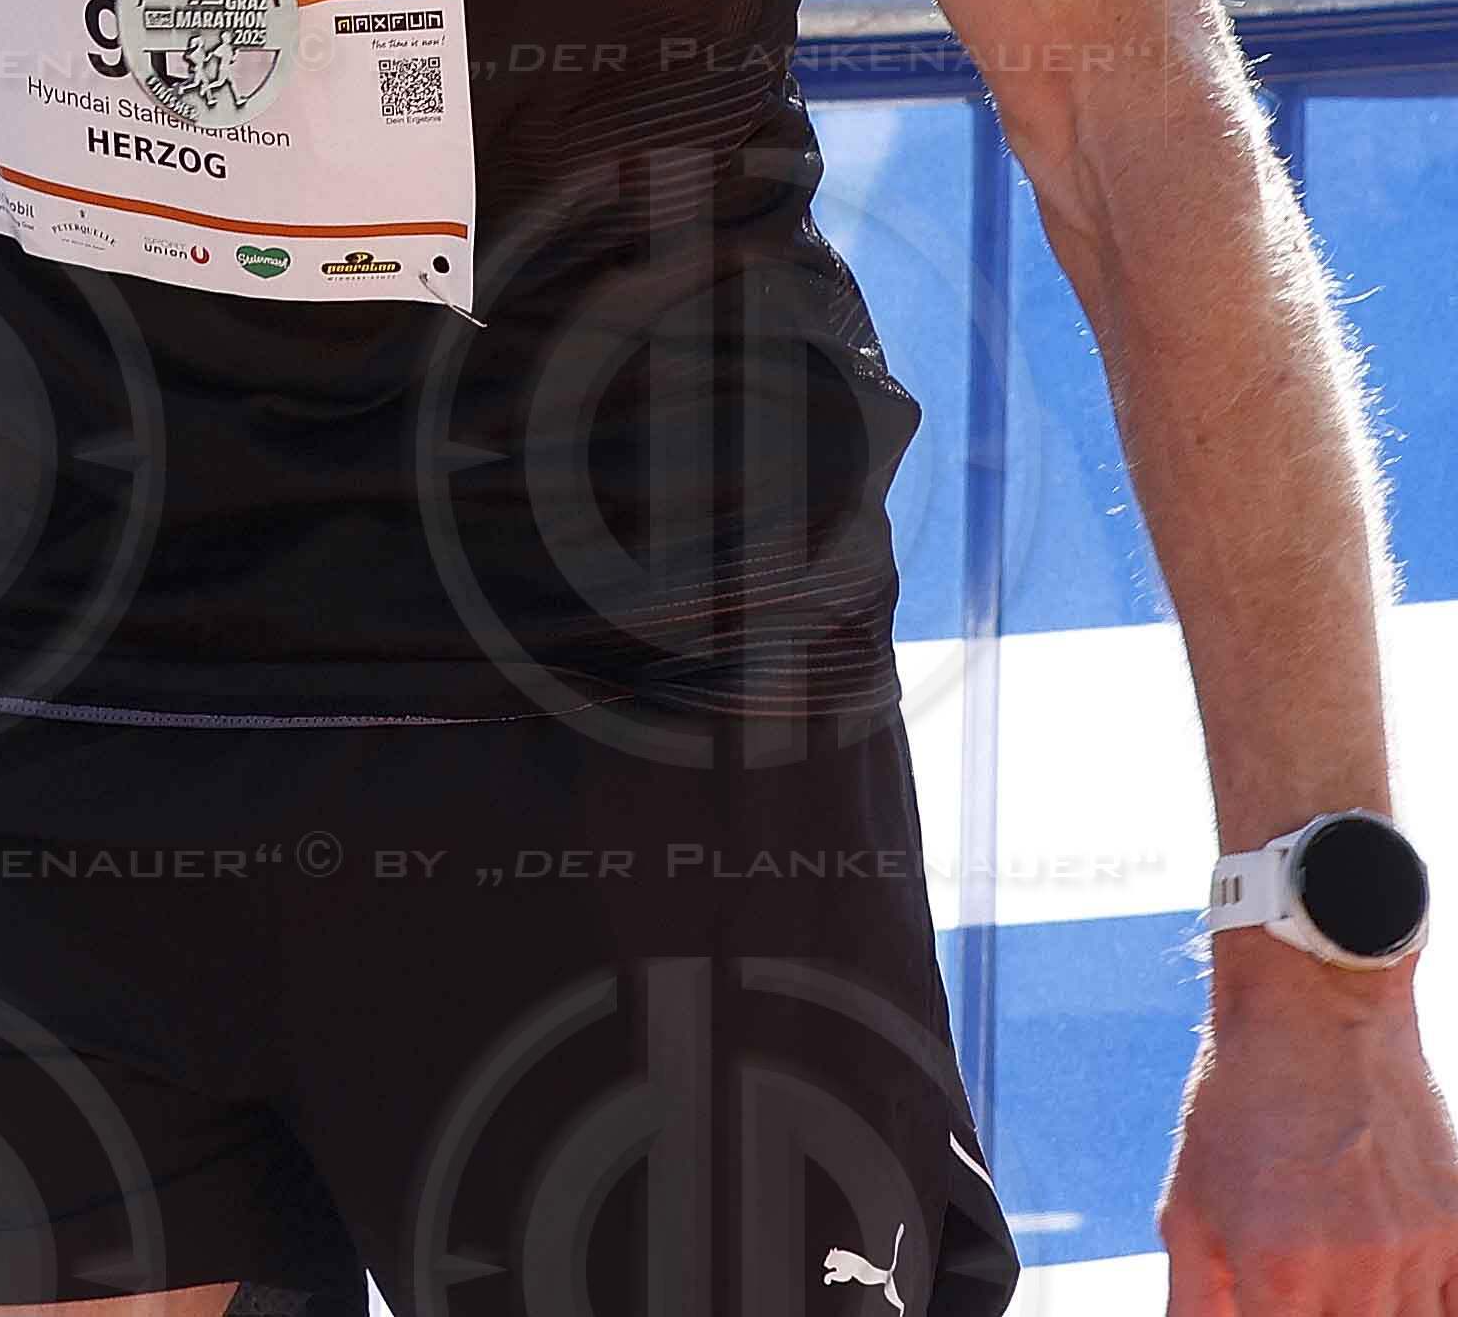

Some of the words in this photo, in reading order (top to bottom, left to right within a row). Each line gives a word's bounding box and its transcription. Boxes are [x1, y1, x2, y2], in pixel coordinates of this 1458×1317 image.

[176, 10, 267, 29] MARATHON
[234, 29, 266, 45] 2025
[27, 76, 110, 115] Hyundai
[87, 125, 227, 179] HERZOG
